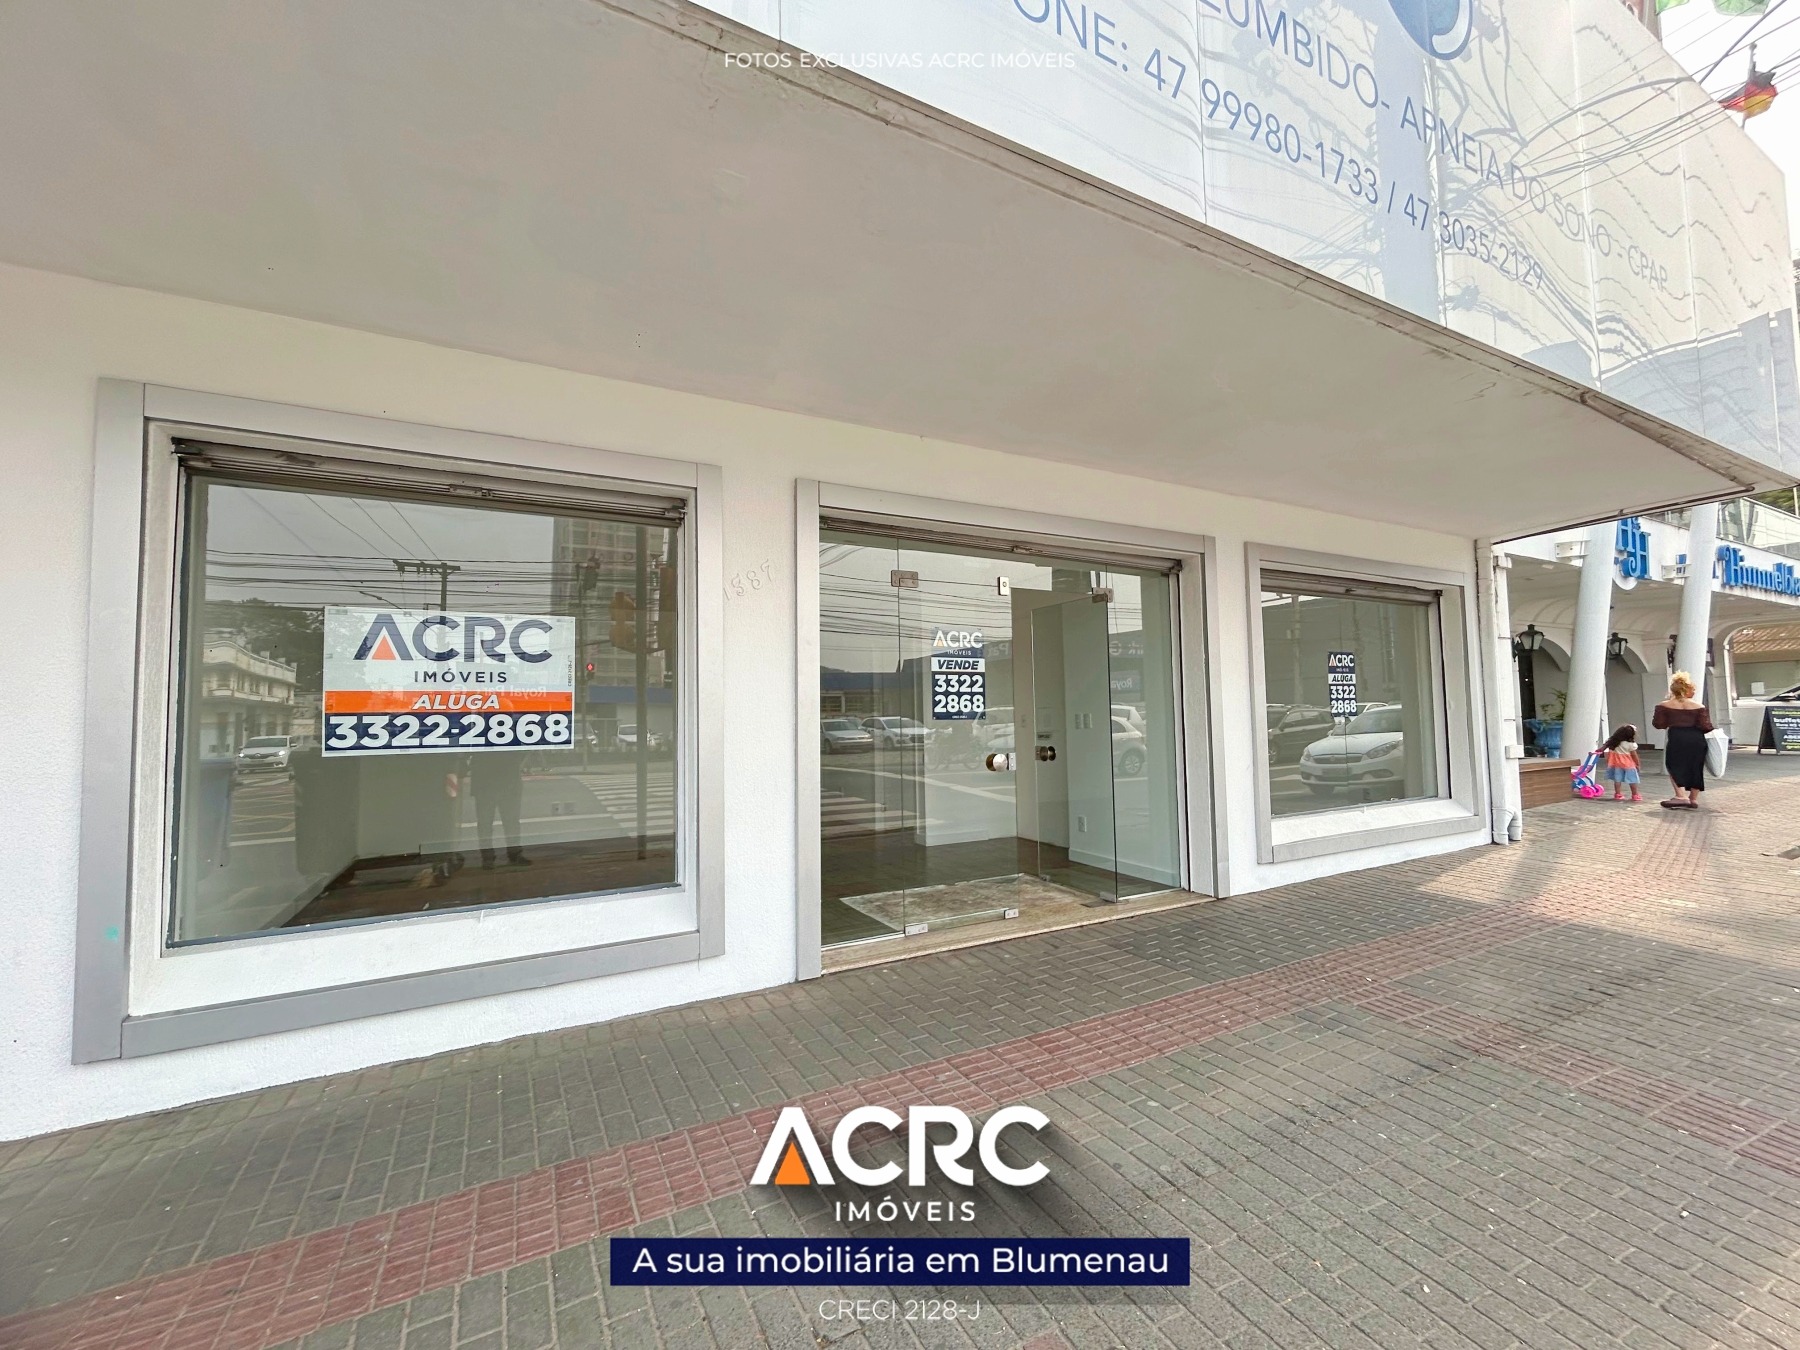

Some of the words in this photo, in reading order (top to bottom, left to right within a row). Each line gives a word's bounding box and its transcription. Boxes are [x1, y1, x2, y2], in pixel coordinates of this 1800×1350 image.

[1201, 0, 1390, 110] UMBIDO-
[1400, 96, 1503, 190] APNEIA
[1510, 162, 1546, 213] DO
[1553, 193, 1612, 257] SONO
[1144, 48, 1187, 99] 47
[1201, 78, 1379, 205] 99980-1733
[1403, 193, 1430, 231] 47
[1438, 211, 1542, 289] 3035-2129
[353, 613, 553, 663] ACRC
[932, 630, 983, 649] ACRC
[937, 659, 980, 671] VENDE
[1329, 654, 1354, 667] ACRC
[414, 668, 508, 683] IMÓVEIS
[934, 674, 984, 693] 3322
[1331, 674, 1354, 683] ALUGA
[1330, 685, 1356, 699] 3322
[412, 694, 500, 711] ALUGA
[934, 694, 985, 713] 2868
[1331, 699, 1357, 714] 2868
[326, 713, 570, 749] 3322-2868
